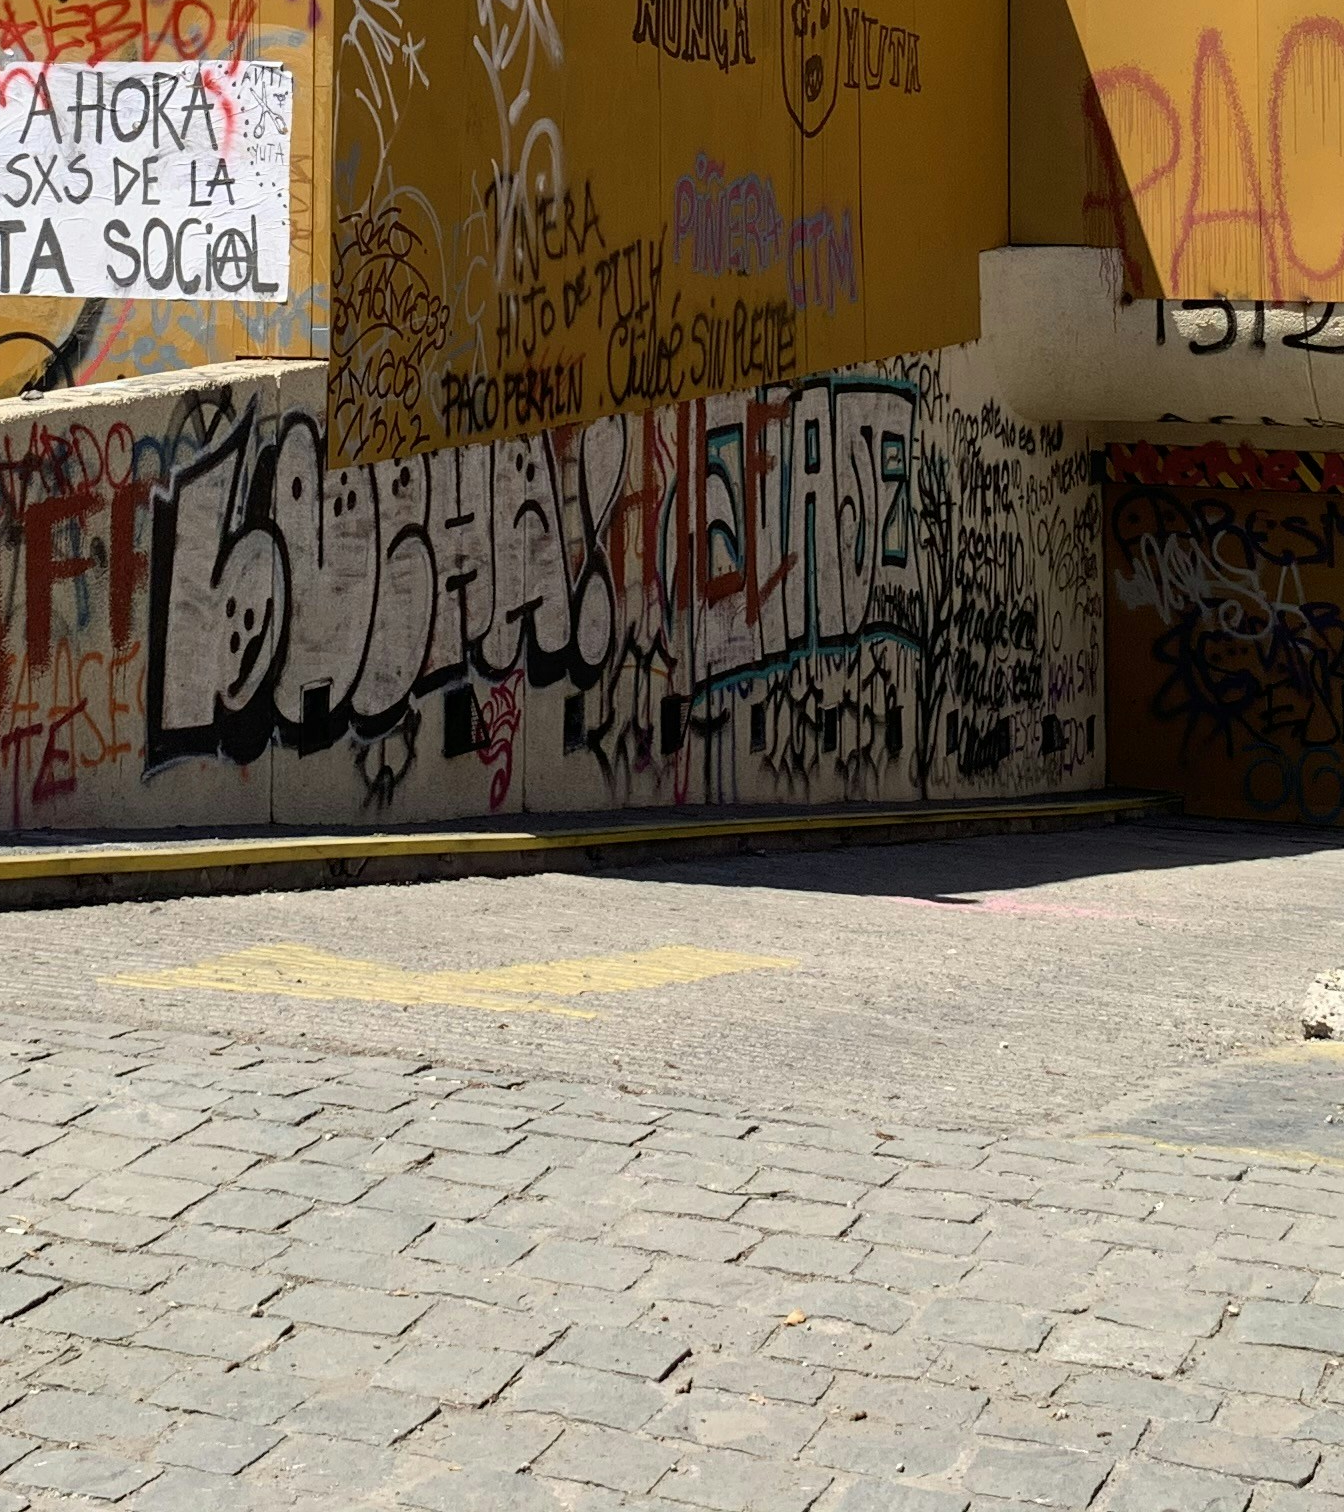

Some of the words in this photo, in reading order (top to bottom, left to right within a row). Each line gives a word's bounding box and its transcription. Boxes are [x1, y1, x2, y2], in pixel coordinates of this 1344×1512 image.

[844, 7, 921, 95] YUTA
[19, 70, 219, 152] AHORA
[113, 154, 159, 206] DE
[190, 156, 236, 206] LA
[441, 371, 498, 436] PACO
